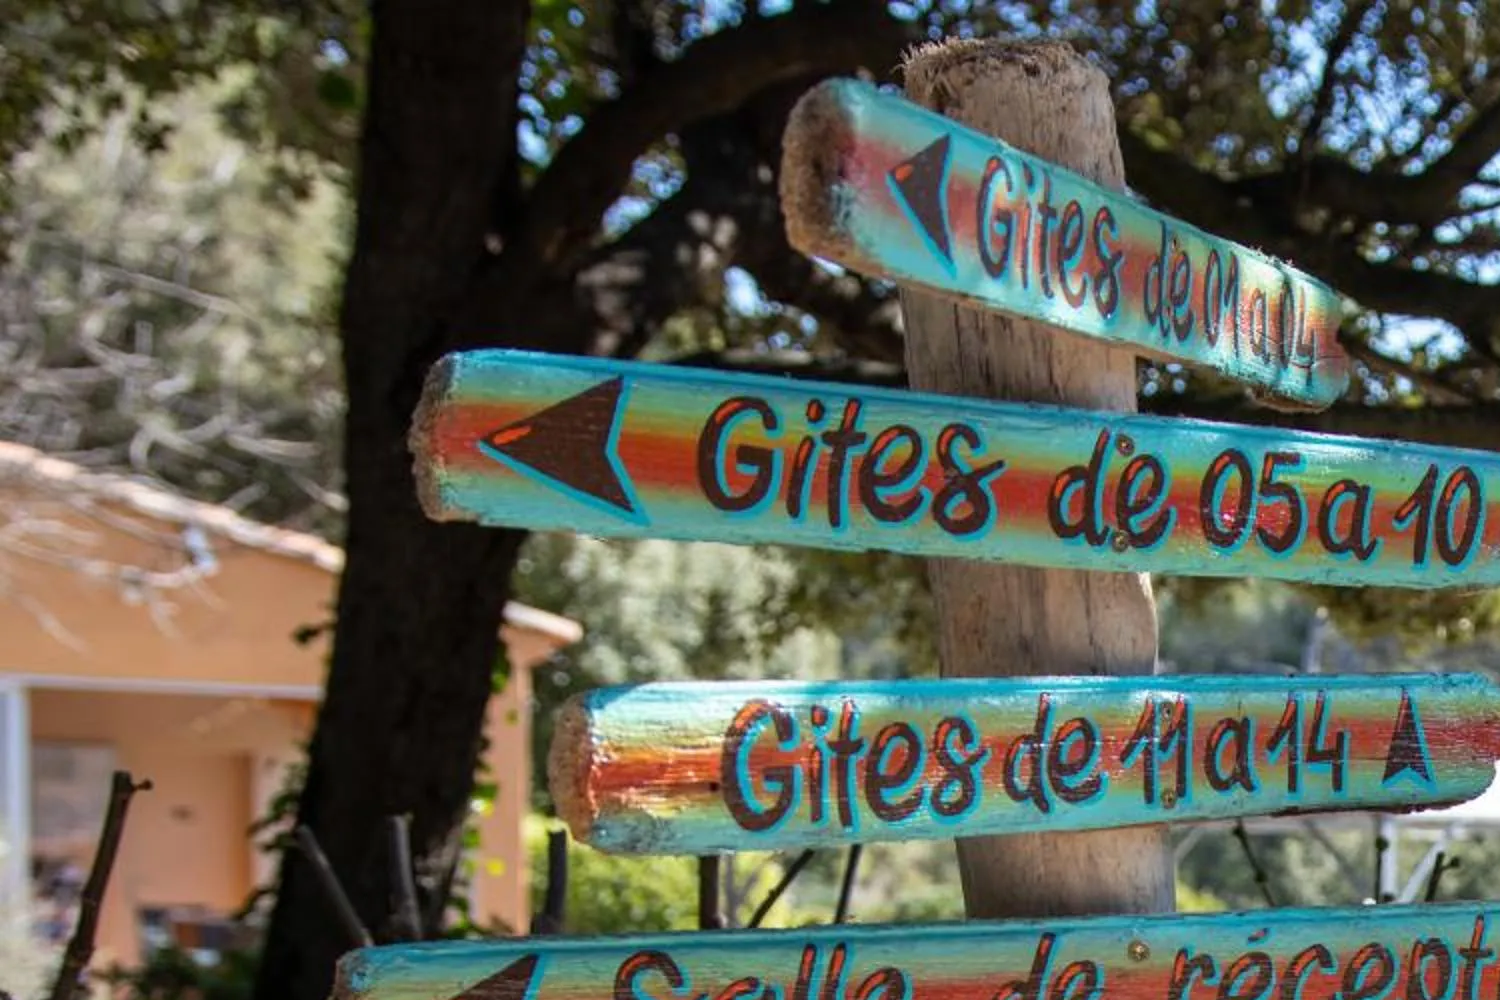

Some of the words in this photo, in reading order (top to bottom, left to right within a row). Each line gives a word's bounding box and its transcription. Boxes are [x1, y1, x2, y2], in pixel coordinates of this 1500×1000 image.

[1144, 220, 1195, 342] de
[1204, 249, 1239, 359] 01
[1278, 274, 1316, 387] 04
[698, 397, 1004, 536] Gites
[1048, 428, 1170, 548] de
[1201, 447, 1301, 553] 05
[1317, 478, 1377, 561] a
[1393, 463, 1482, 567] 10
[722, 697, 988, 832] Gites
[1003, 692, 1106, 813] de
[1120, 693, 1187, 804] 11
[1204, 717, 1256, 792] a
[1267, 690, 1343, 793] 14
